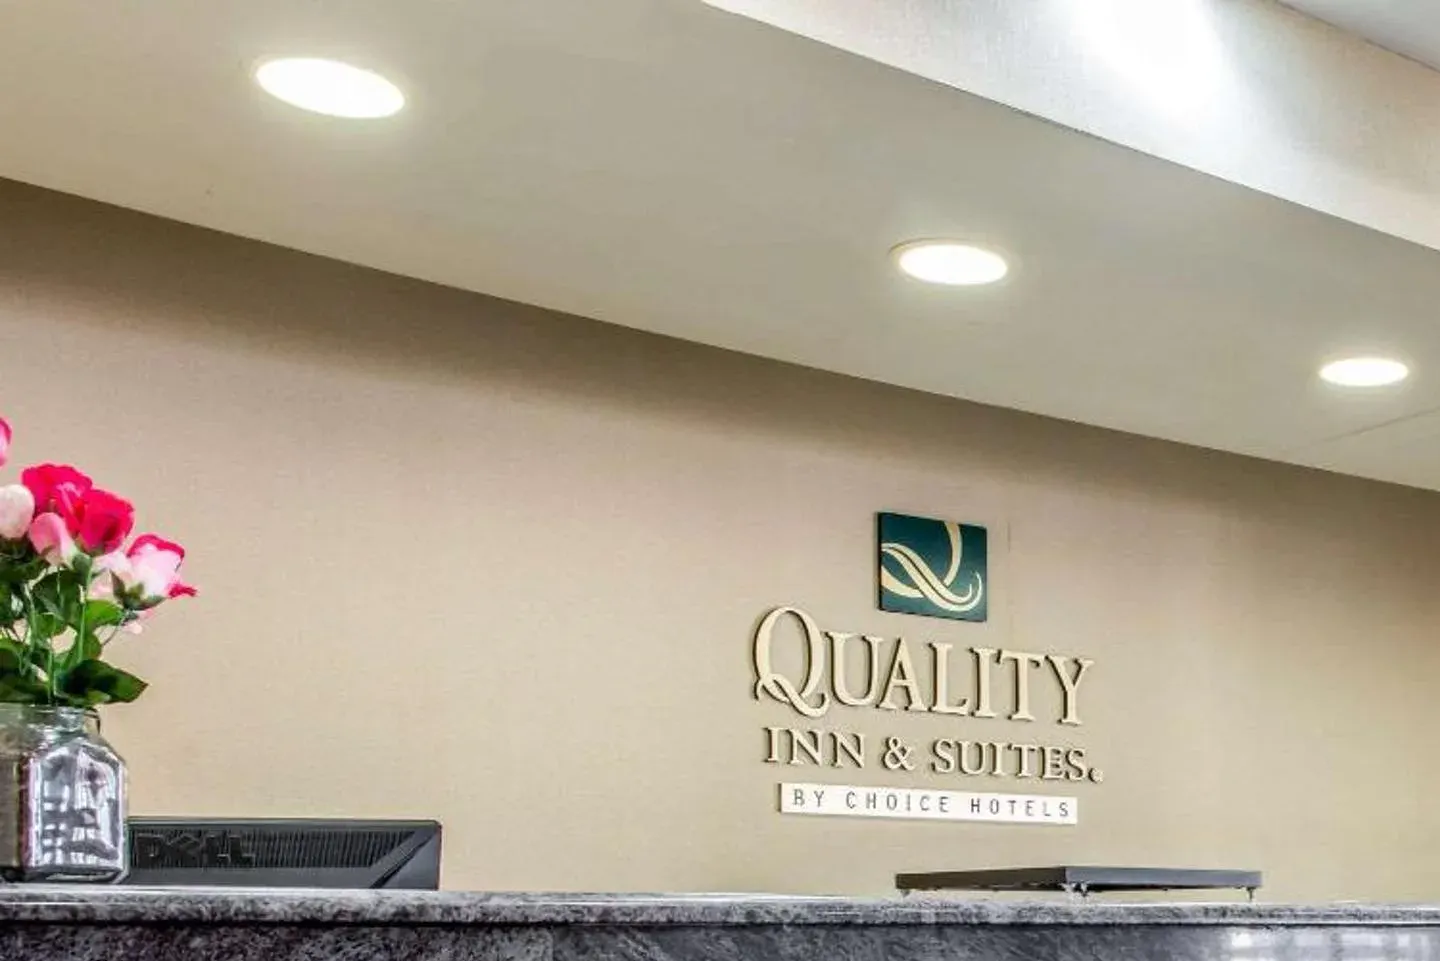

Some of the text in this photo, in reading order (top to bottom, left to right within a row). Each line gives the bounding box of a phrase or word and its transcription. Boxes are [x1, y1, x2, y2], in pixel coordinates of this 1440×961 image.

[752, 605, 1095, 726] QUALITY
[763, 726, 1089, 783] INN & SUITES
[793, 788, 1069, 818] BY CHOICE HOTELS
